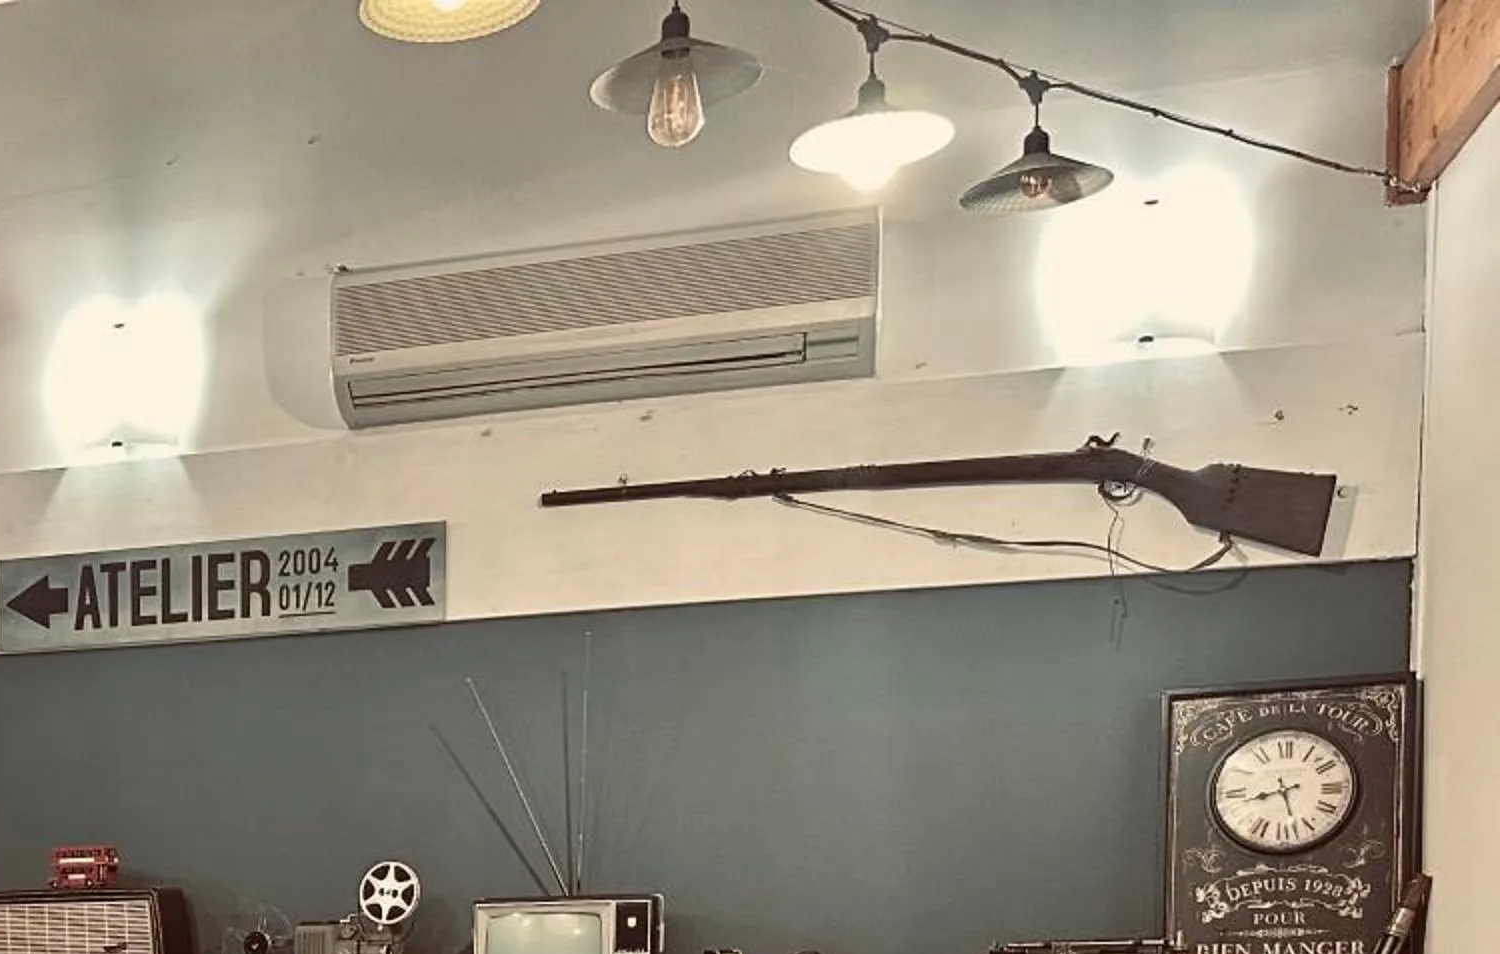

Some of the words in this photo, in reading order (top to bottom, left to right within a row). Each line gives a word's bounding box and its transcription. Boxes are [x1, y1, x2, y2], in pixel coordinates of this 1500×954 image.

[278, 545, 340, 577] 2004
[73, 549, 272, 631] ATELIER
[278, 581, 336, 612] 01/12
[1315, 702, 1370, 732] TOUR
[1225, 877, 1298, 901] DEPUIS
[1304, 878, 1344, 898] 1928
[1252, 910, 1306, 925] POUR
